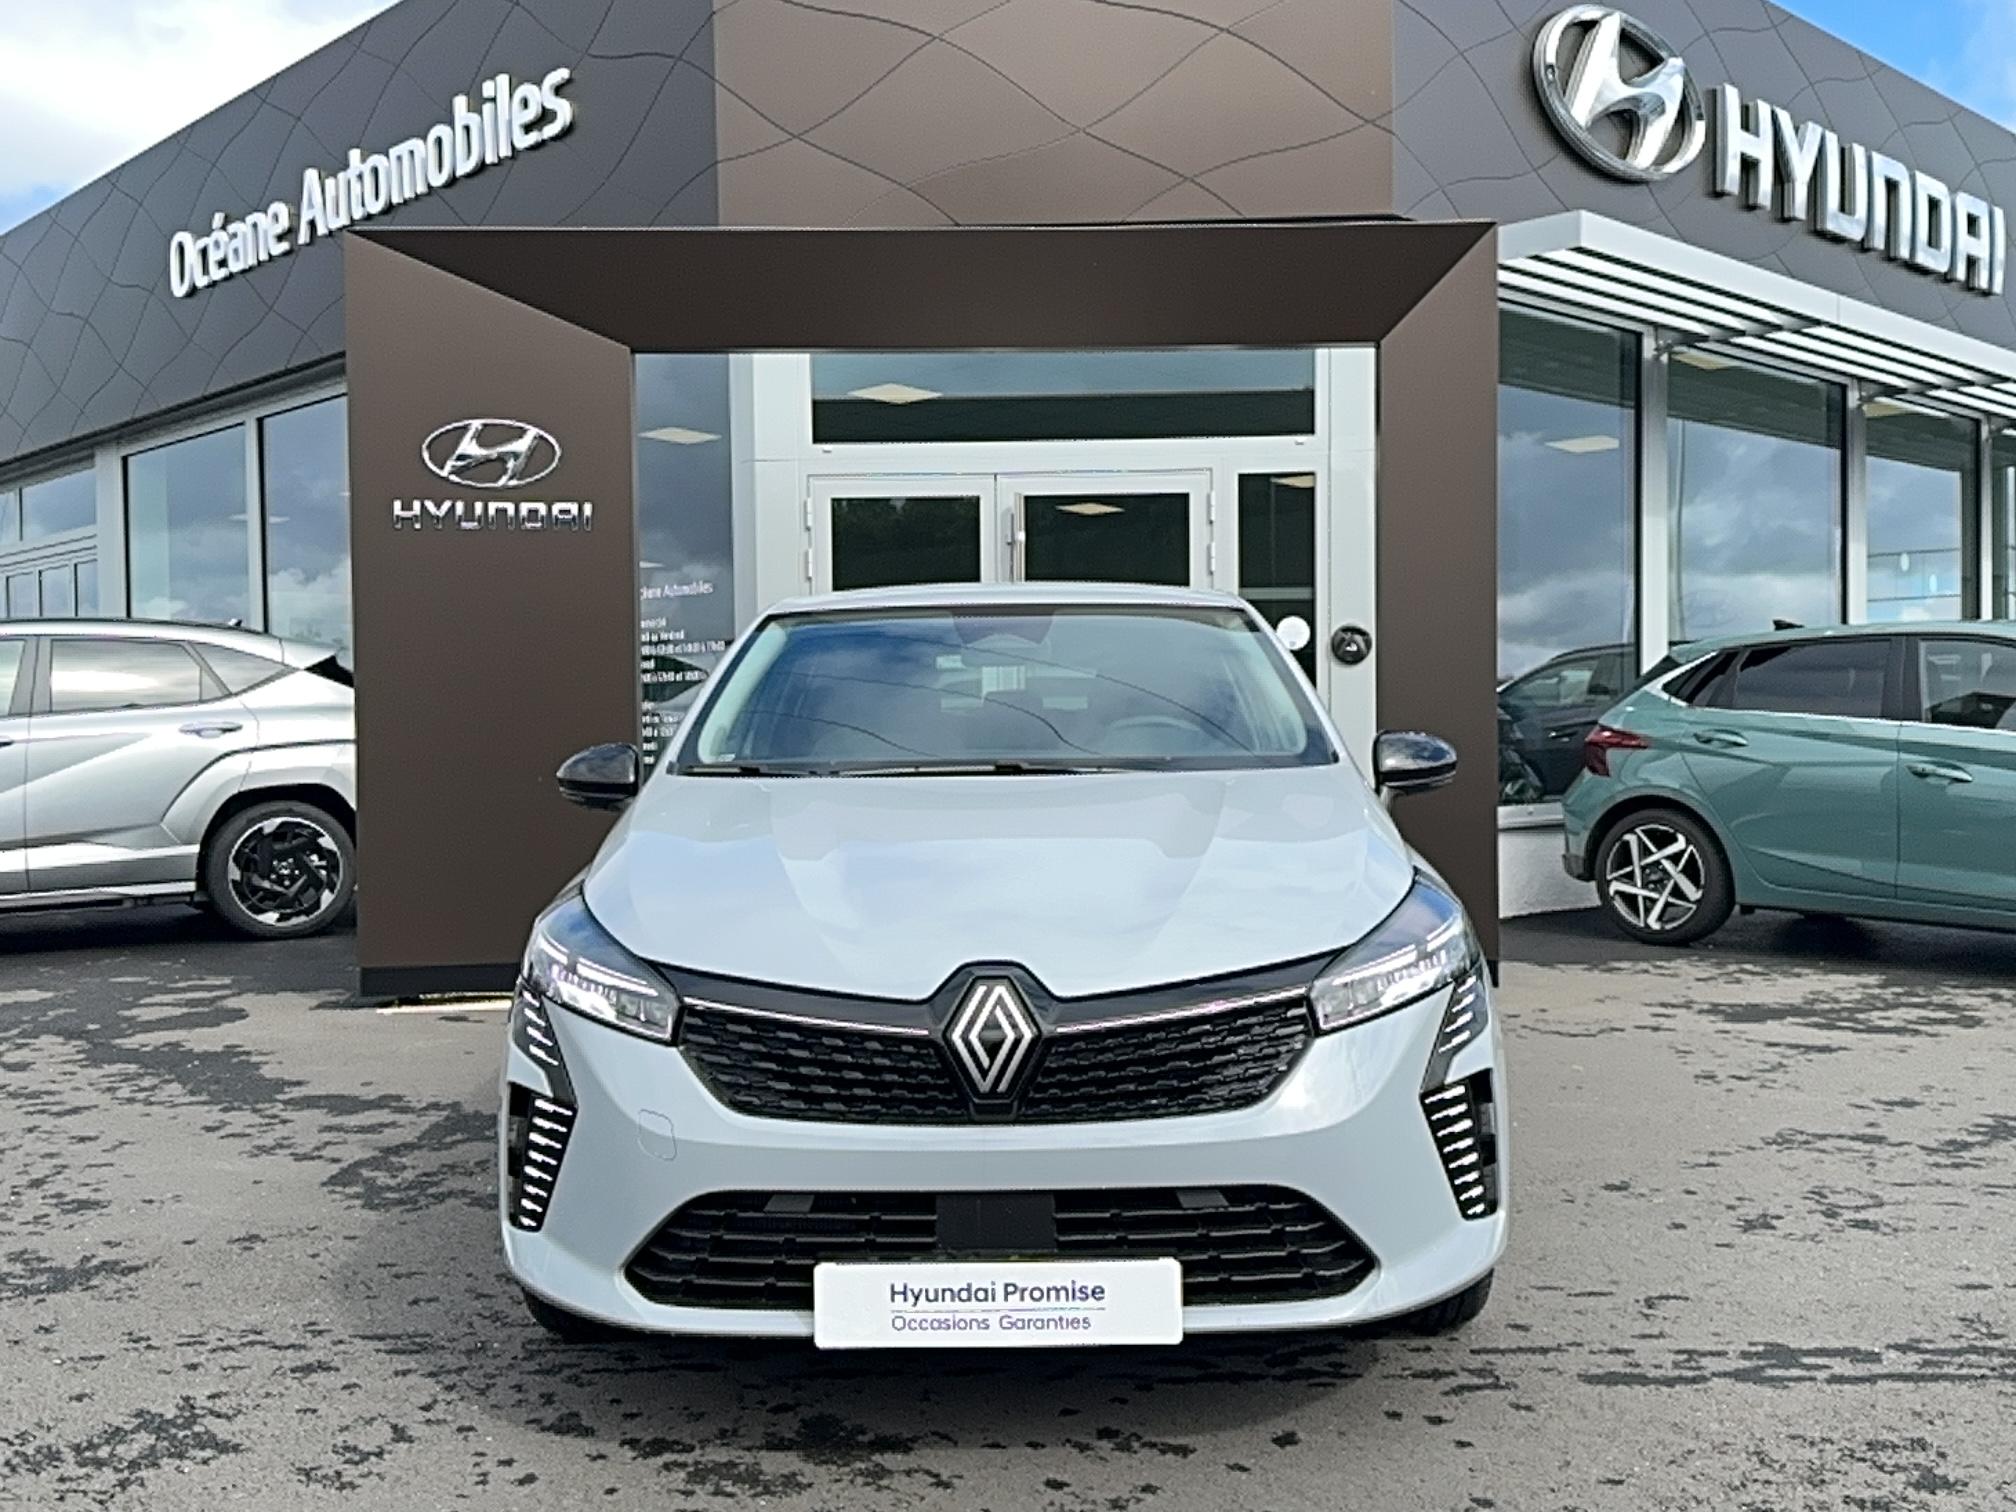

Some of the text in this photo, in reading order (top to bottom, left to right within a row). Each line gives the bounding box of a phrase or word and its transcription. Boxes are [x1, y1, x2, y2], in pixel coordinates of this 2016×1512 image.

[169, 67, 574, 298] Océane Automobiles
[1711, 82, 2006, 297] HYUNDAI
[393, 499, 593, 531] HYUNDAI
[890, 1280, 1106, 1307] Hyundai Promise
[891, 1314, 1092, 1332] Occasions Garanties
